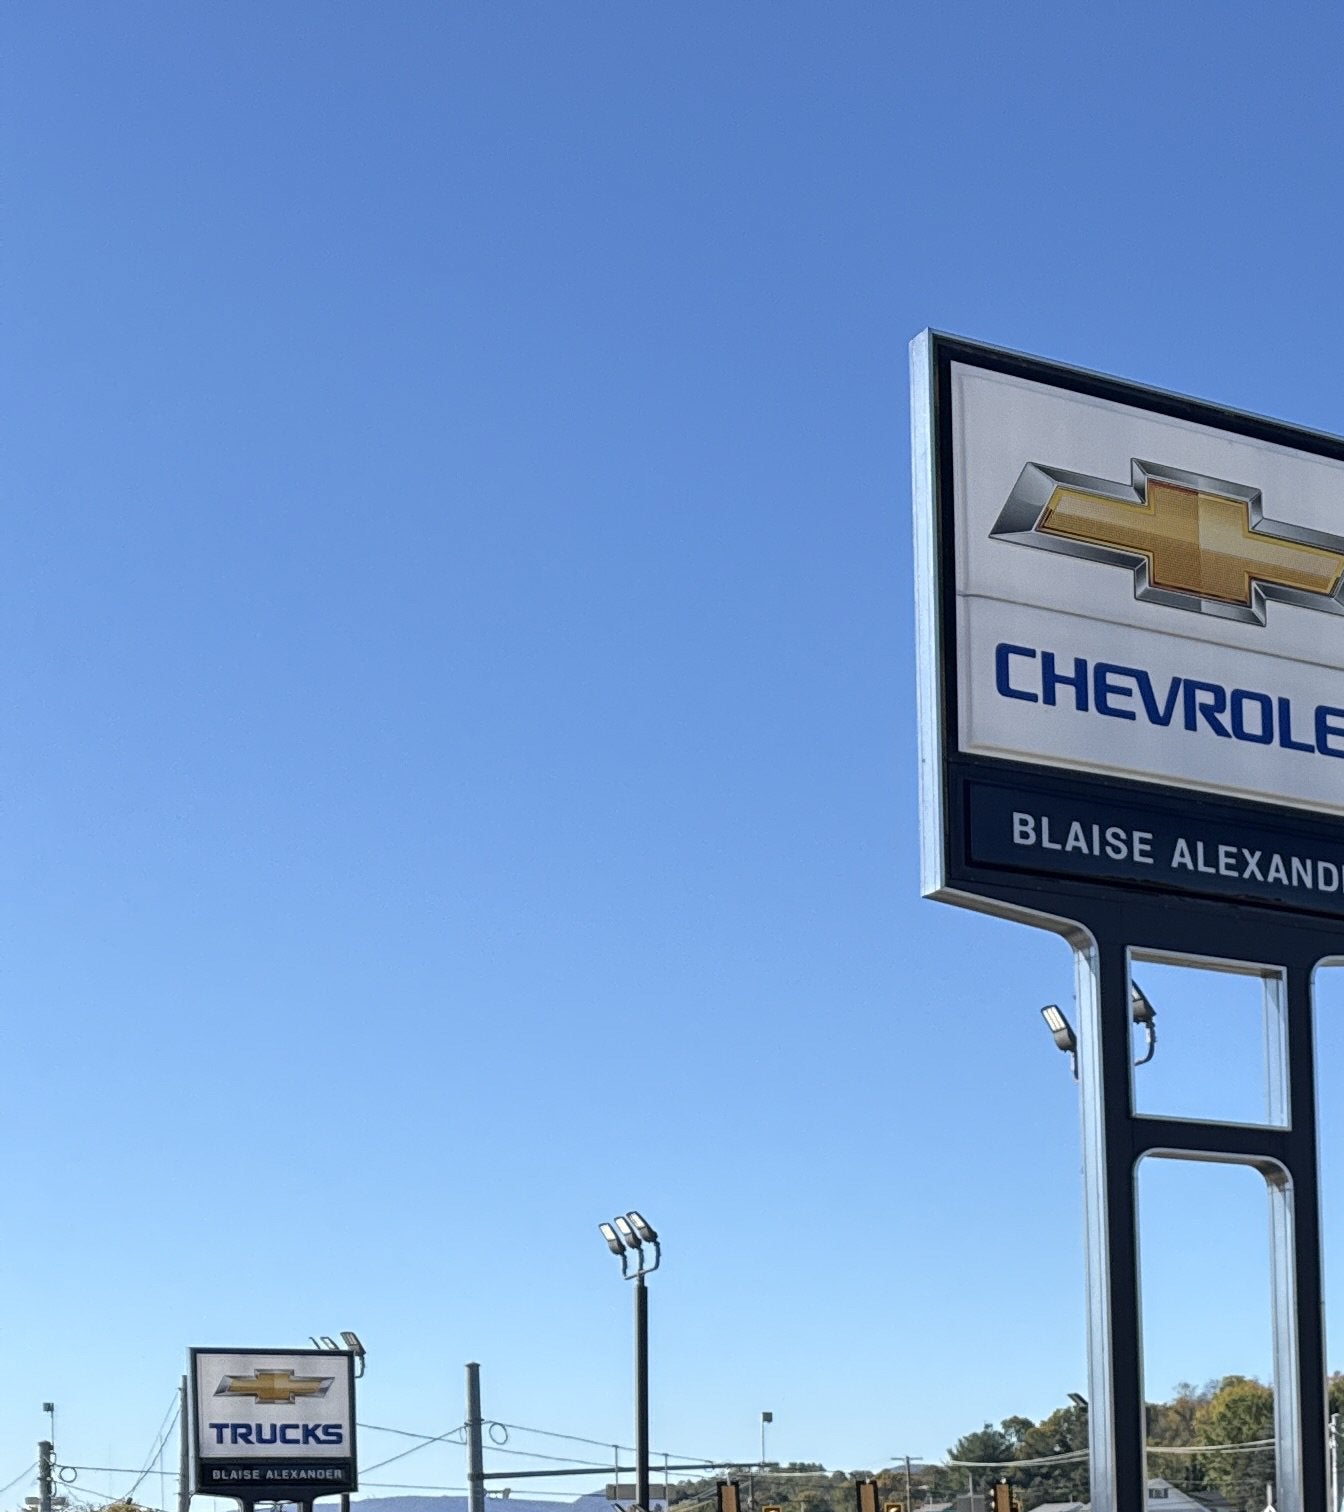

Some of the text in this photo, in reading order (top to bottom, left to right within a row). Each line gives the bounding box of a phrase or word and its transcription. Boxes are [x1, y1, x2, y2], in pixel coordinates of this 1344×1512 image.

[1011, 811, 1155, 865] BLAISE
[209, 1422, 343, 1445] TRUCKS
[212, 1469, 342, 1480] BLAISE ALEXANDER
